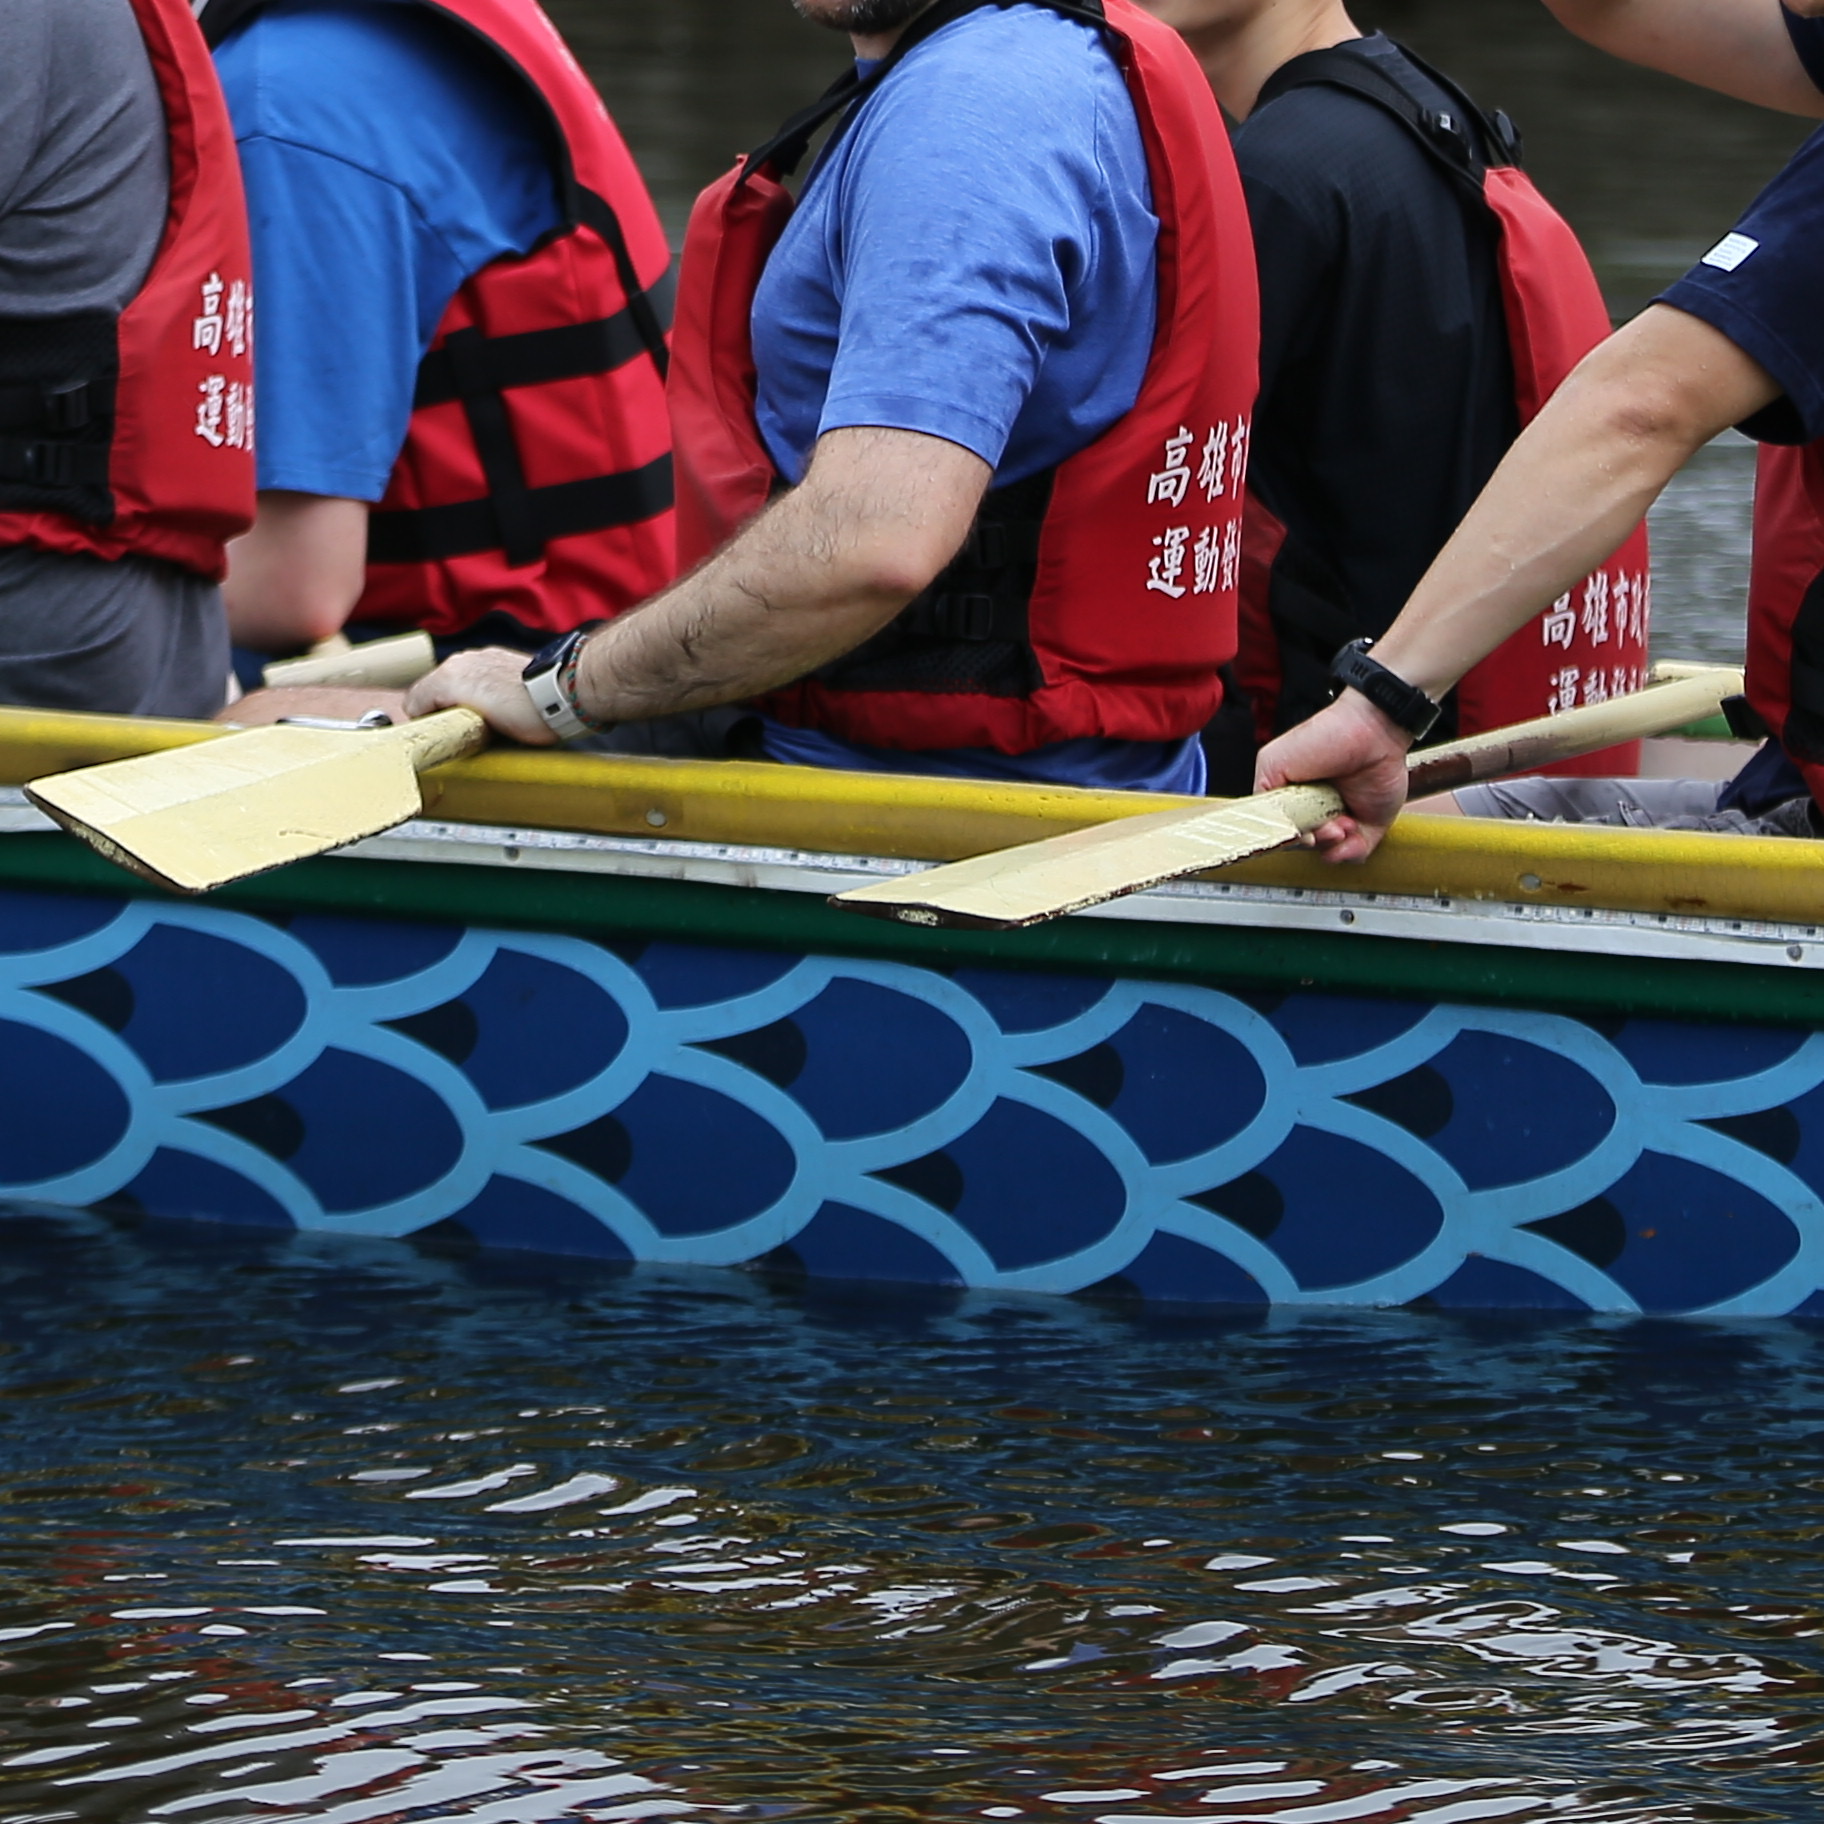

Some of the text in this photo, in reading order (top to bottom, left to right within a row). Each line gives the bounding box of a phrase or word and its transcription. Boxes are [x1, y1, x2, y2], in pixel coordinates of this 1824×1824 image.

[1147, 414, 1251, 509] 高雄市
[1146, 516, 1244, 599] 運動發
[1542, 568, 1651, 651] 高雄市政
